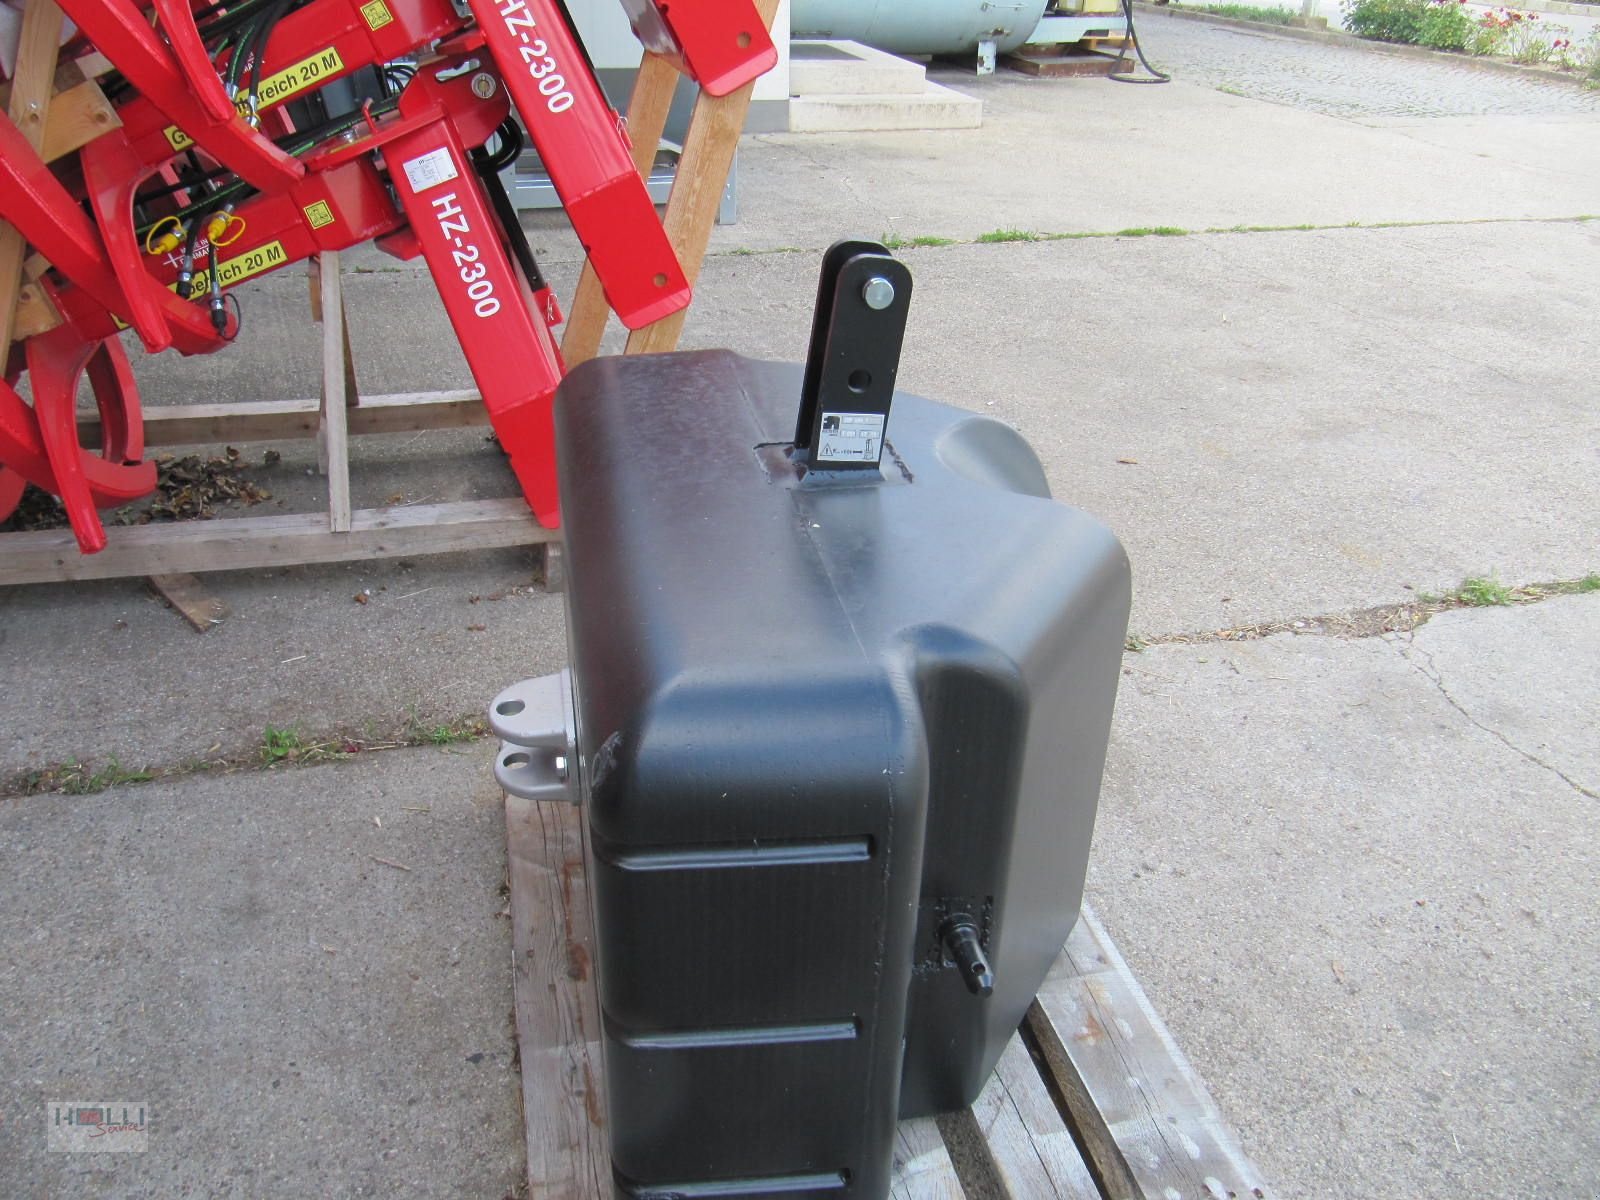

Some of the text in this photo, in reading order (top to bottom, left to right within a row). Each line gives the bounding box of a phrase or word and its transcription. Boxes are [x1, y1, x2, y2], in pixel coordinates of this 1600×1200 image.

[300, 62, 320, 82] 20
[322, 52, 338, 72] M
[495, 0, 574, 113] HZ-2300
[245, 253, 264, 272] 20
[267, 246, 281, 263] M
[431, 192, 501, 318] HZ-2300
